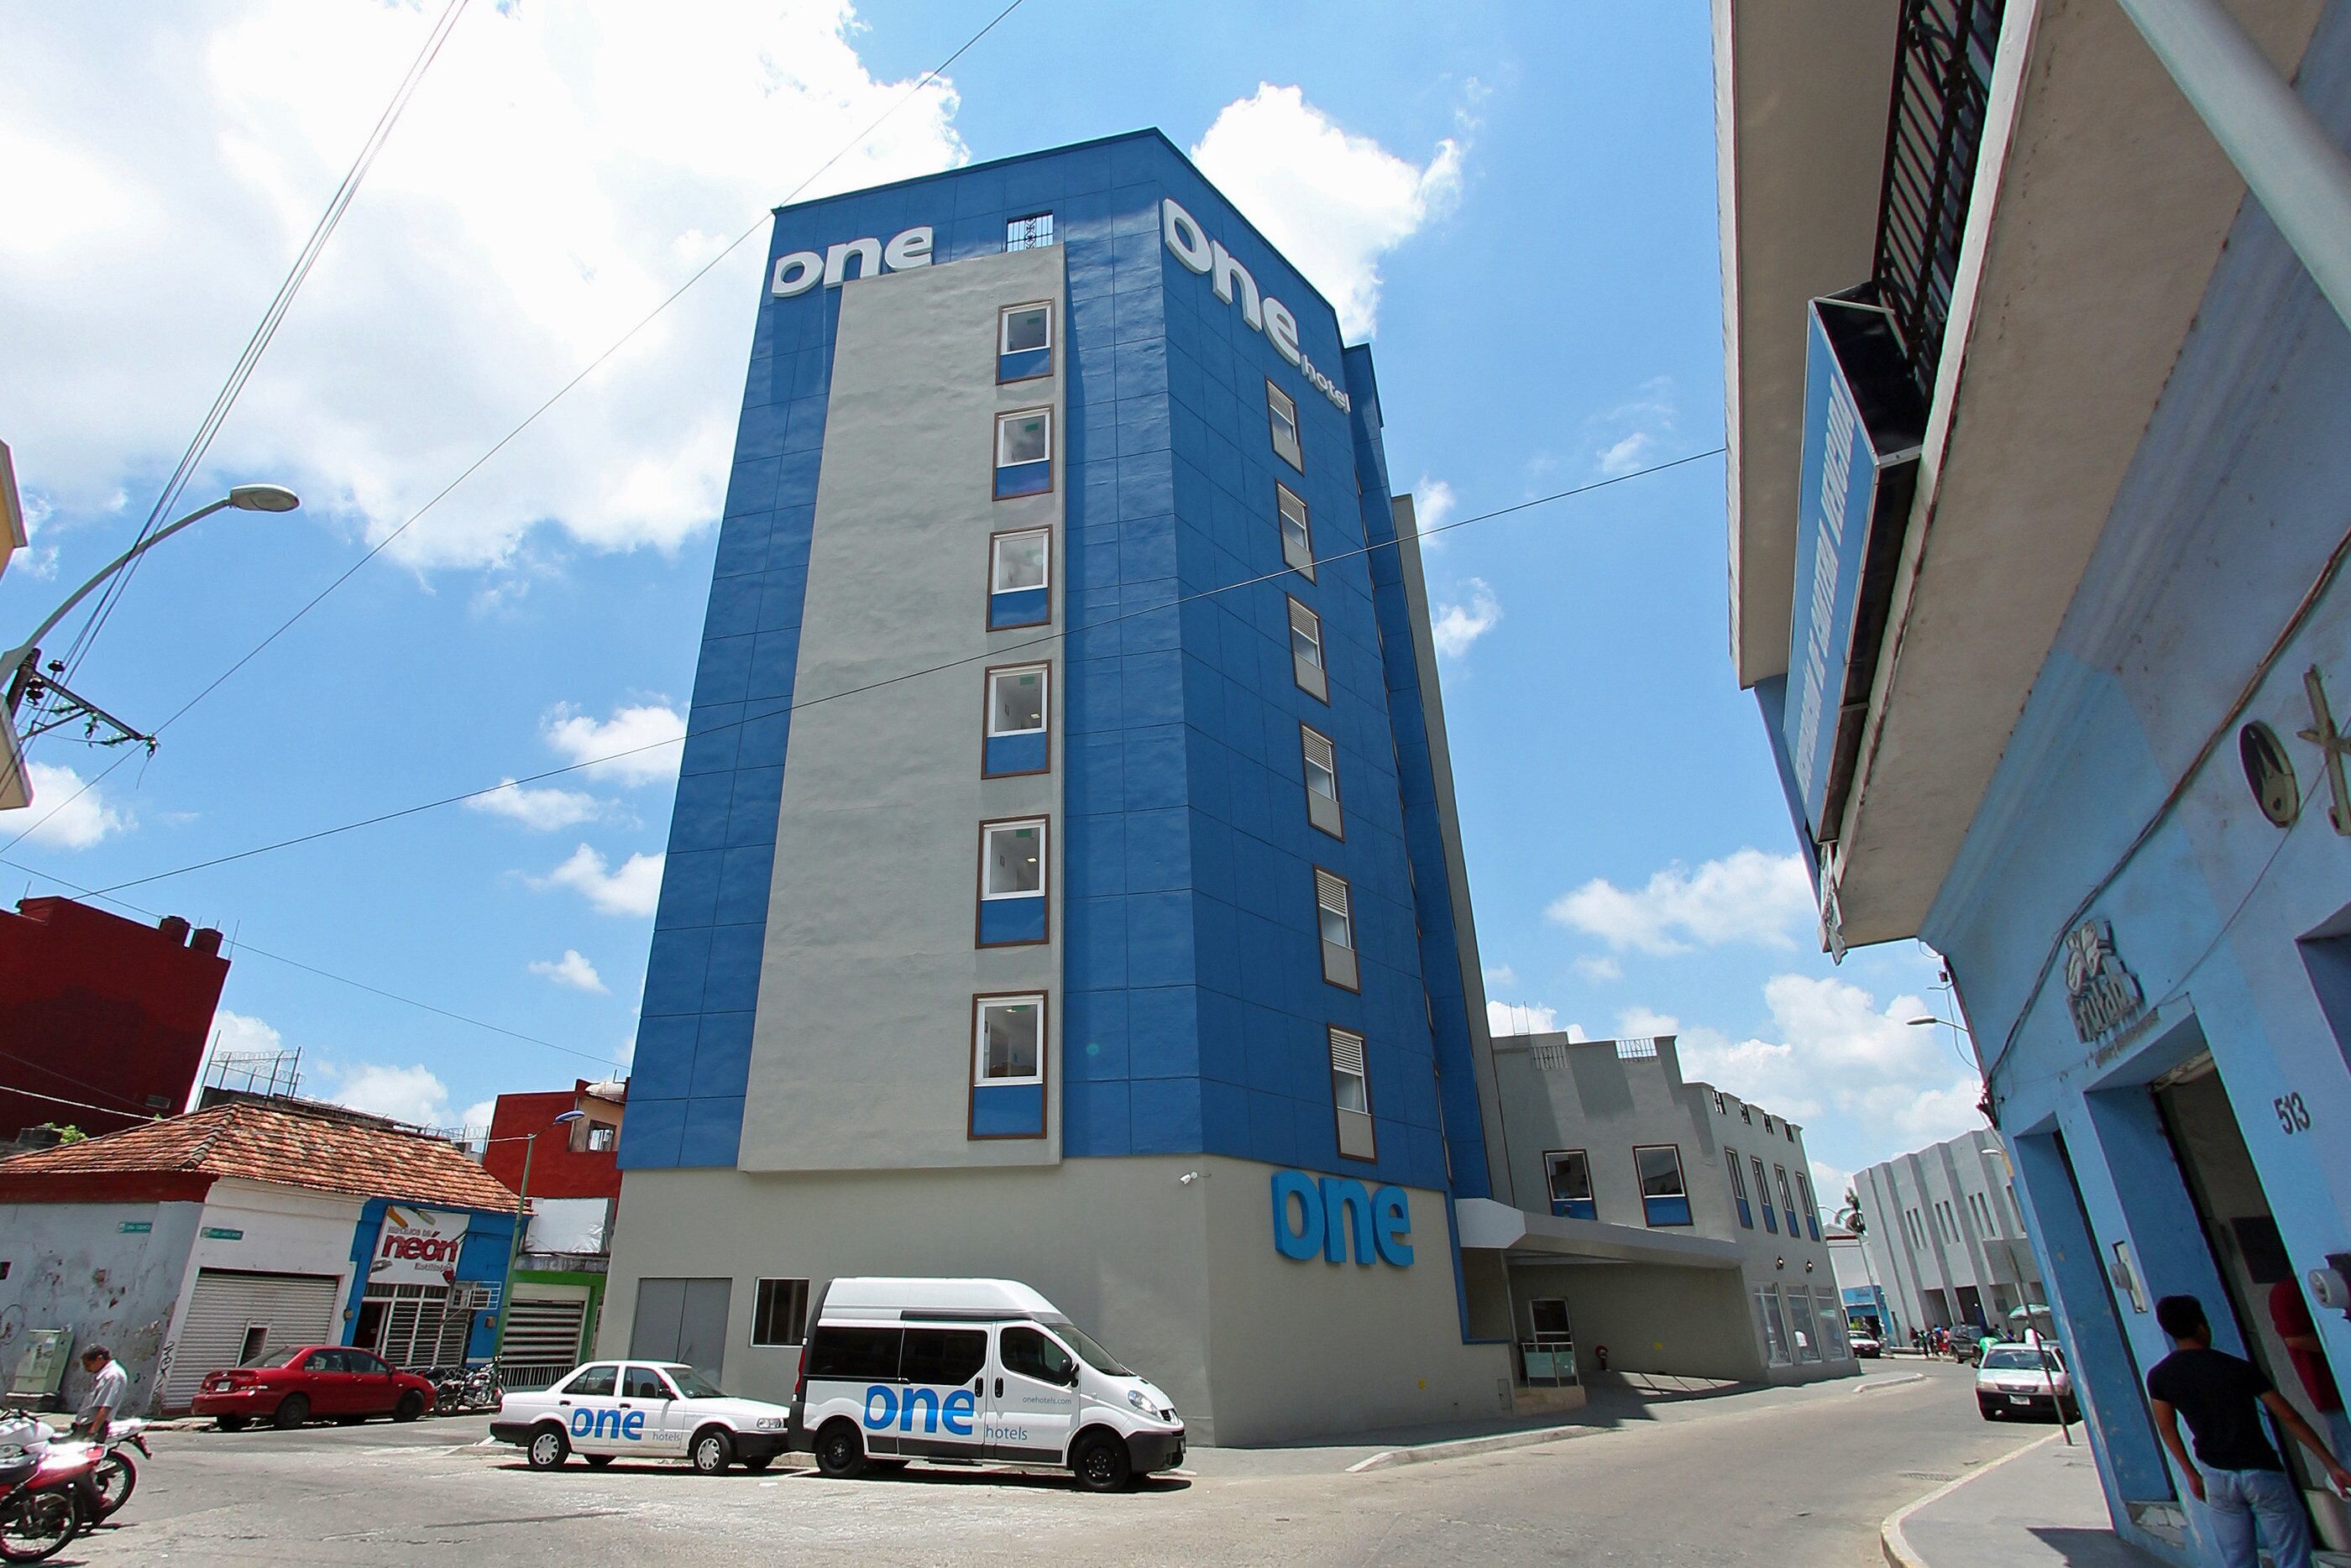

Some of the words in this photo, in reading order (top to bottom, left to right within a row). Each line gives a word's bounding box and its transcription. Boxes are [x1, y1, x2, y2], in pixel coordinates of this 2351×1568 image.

[771, 226, 934, 298] one
[1162, 197, 1301, 367] one
[1301, 353, 1351, 415] hotel
[2273, 1091, 2311, 1135] 513
[1270, 1169, 1415, 1267] one
[381, 1231, 458, 1262] neón
[570, 1407, 646, 1441] one
[652, 1431, 682, 1442] hotels
[863, 1384, 975, 1436] one
[985, 1424, 1028, 1441] hotels
[1022, 1396, 1072, 1405] onehotels.com
